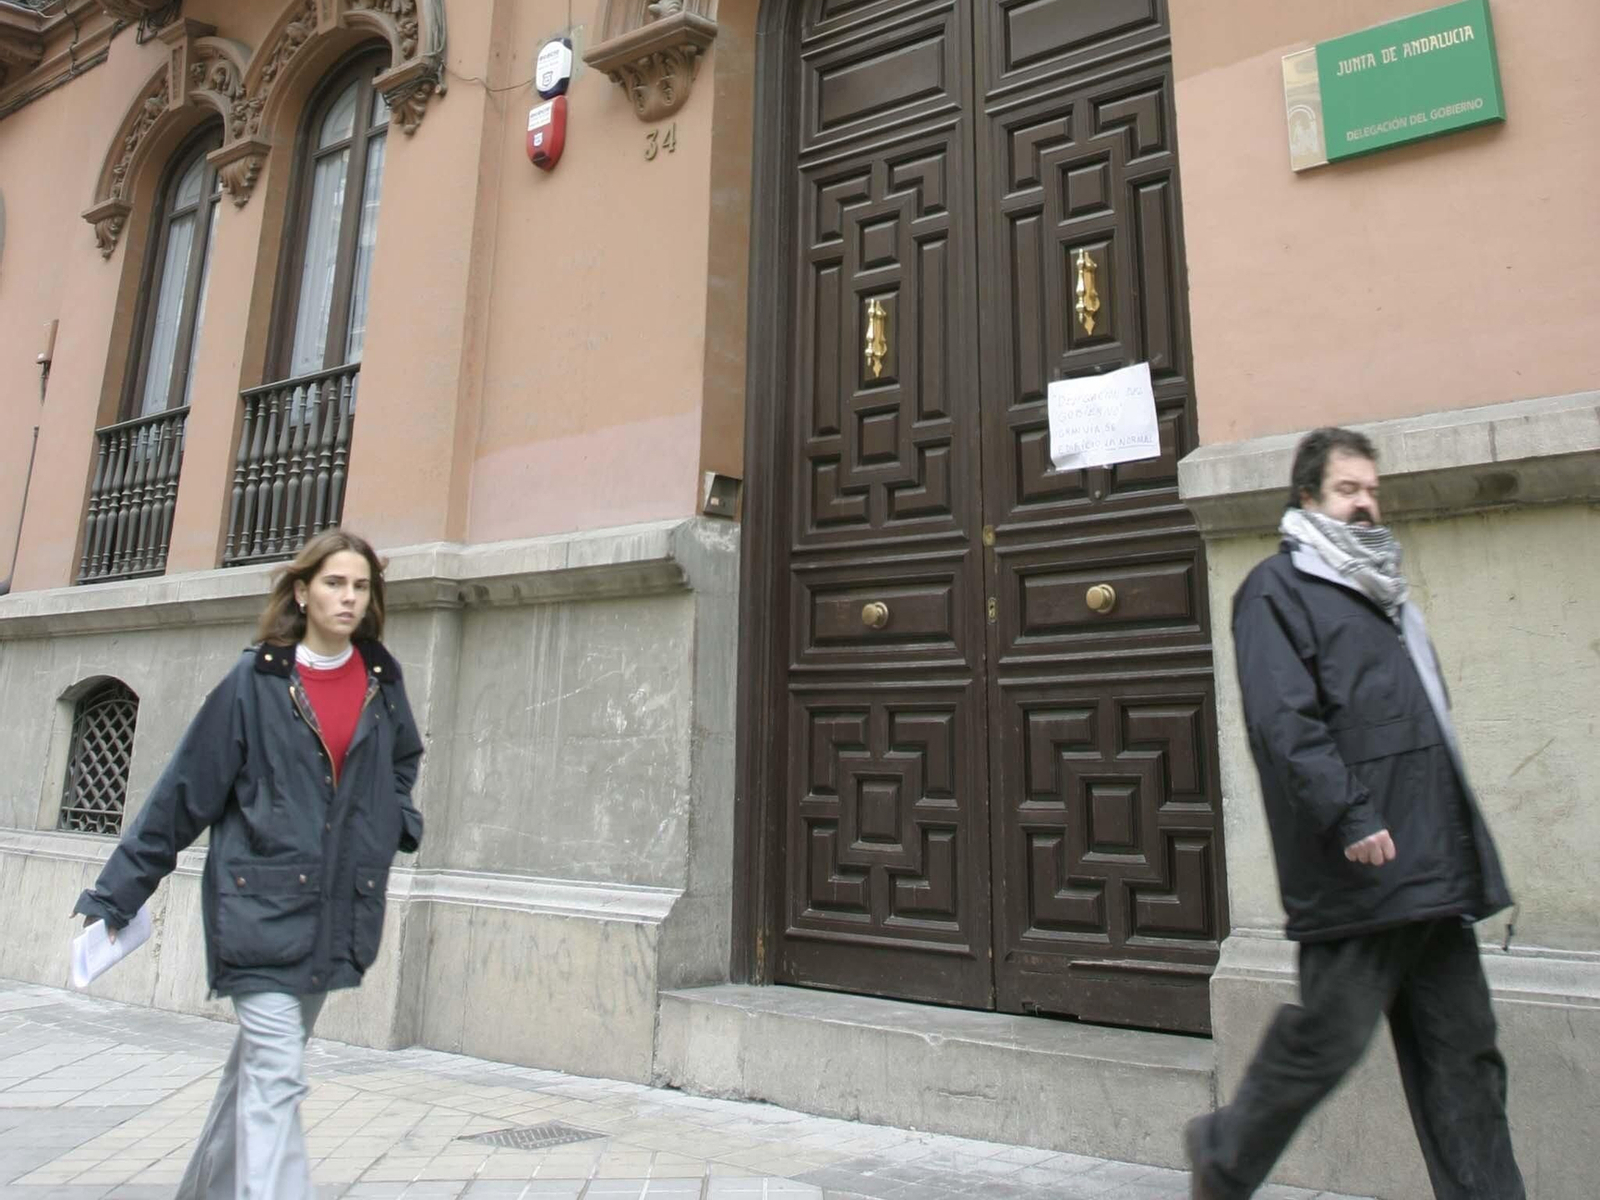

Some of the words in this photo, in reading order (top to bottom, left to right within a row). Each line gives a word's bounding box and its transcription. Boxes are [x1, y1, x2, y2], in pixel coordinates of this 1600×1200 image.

[1336, 53, 1376, 76] JUNTA
[1381, 46, 1398, 64] DE
[1346, 116, 1407, 142] DELEGACIÓN
[1409, 112, 1428, 129] DEL
[1430, 98, 1484, 120] GOBIERNO
[644, 122, 677, 160] 34
[1119, 434, 1153, 446] NORMAL
